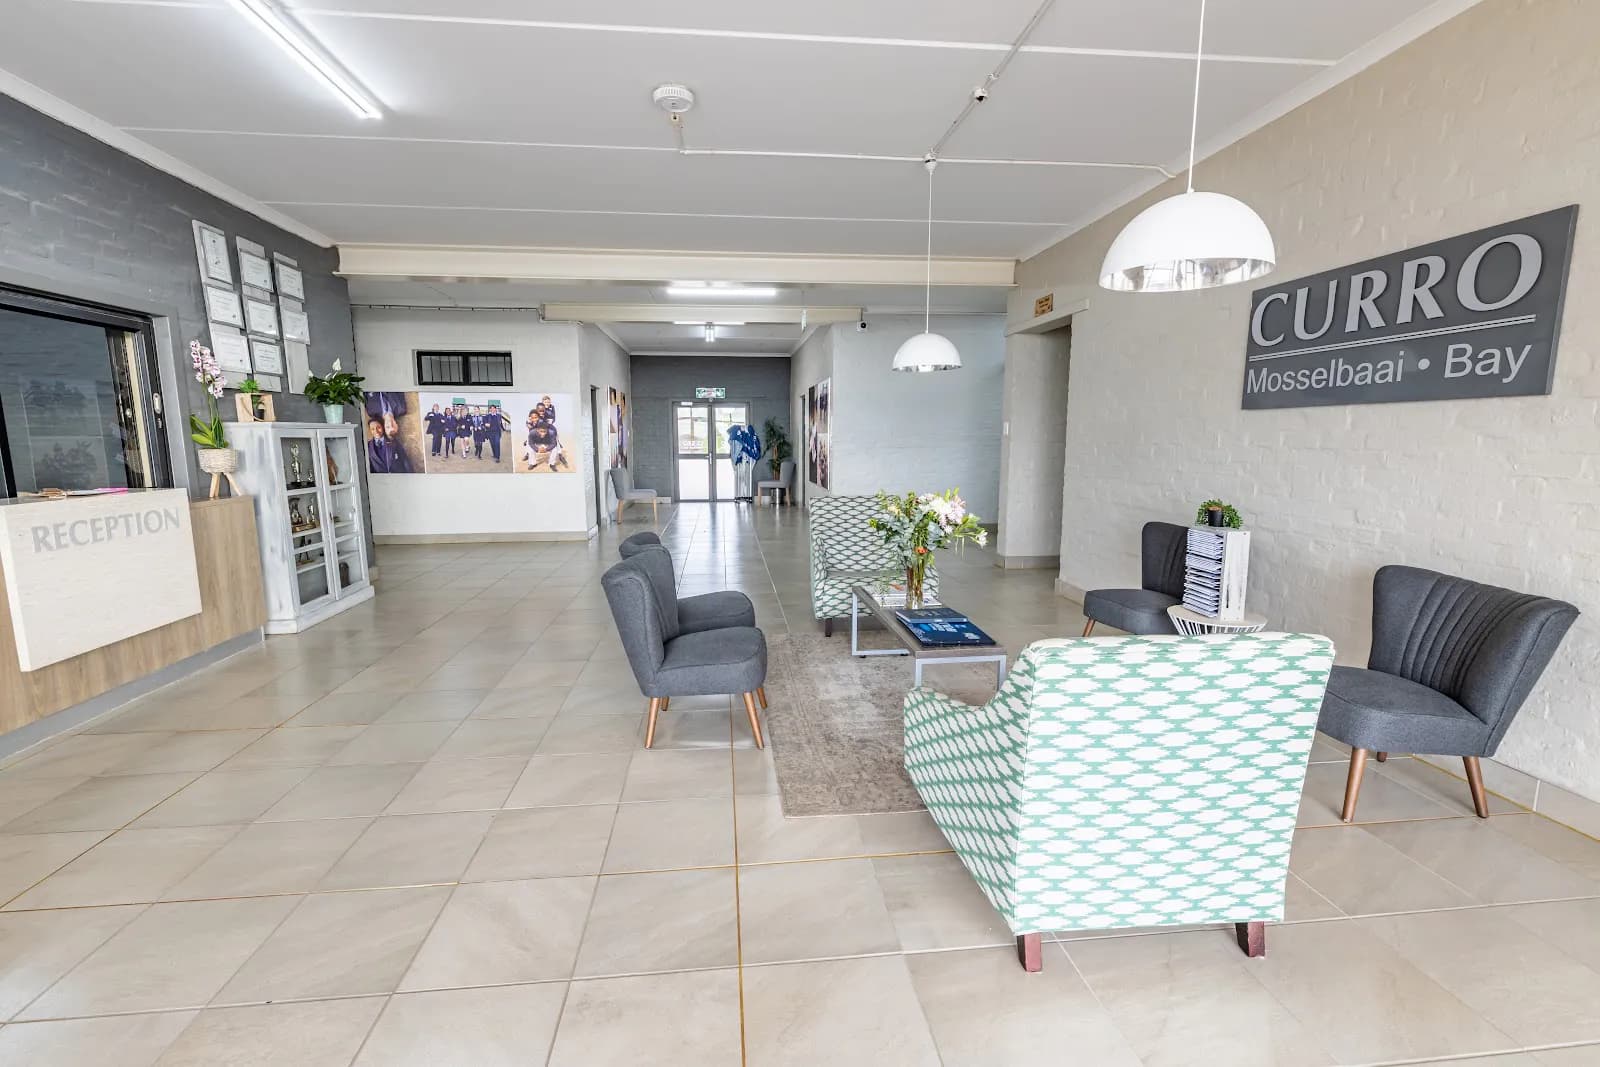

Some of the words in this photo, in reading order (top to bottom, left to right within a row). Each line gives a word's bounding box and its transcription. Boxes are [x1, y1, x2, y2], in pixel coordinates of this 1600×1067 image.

[1251, 233, 1542, 347] CURRO
[1246, 350, 1405, 394] Mosselbaai
[1444, 343, 1532, 383] Bay
[31, 506, 180, 553] RECEPTION
